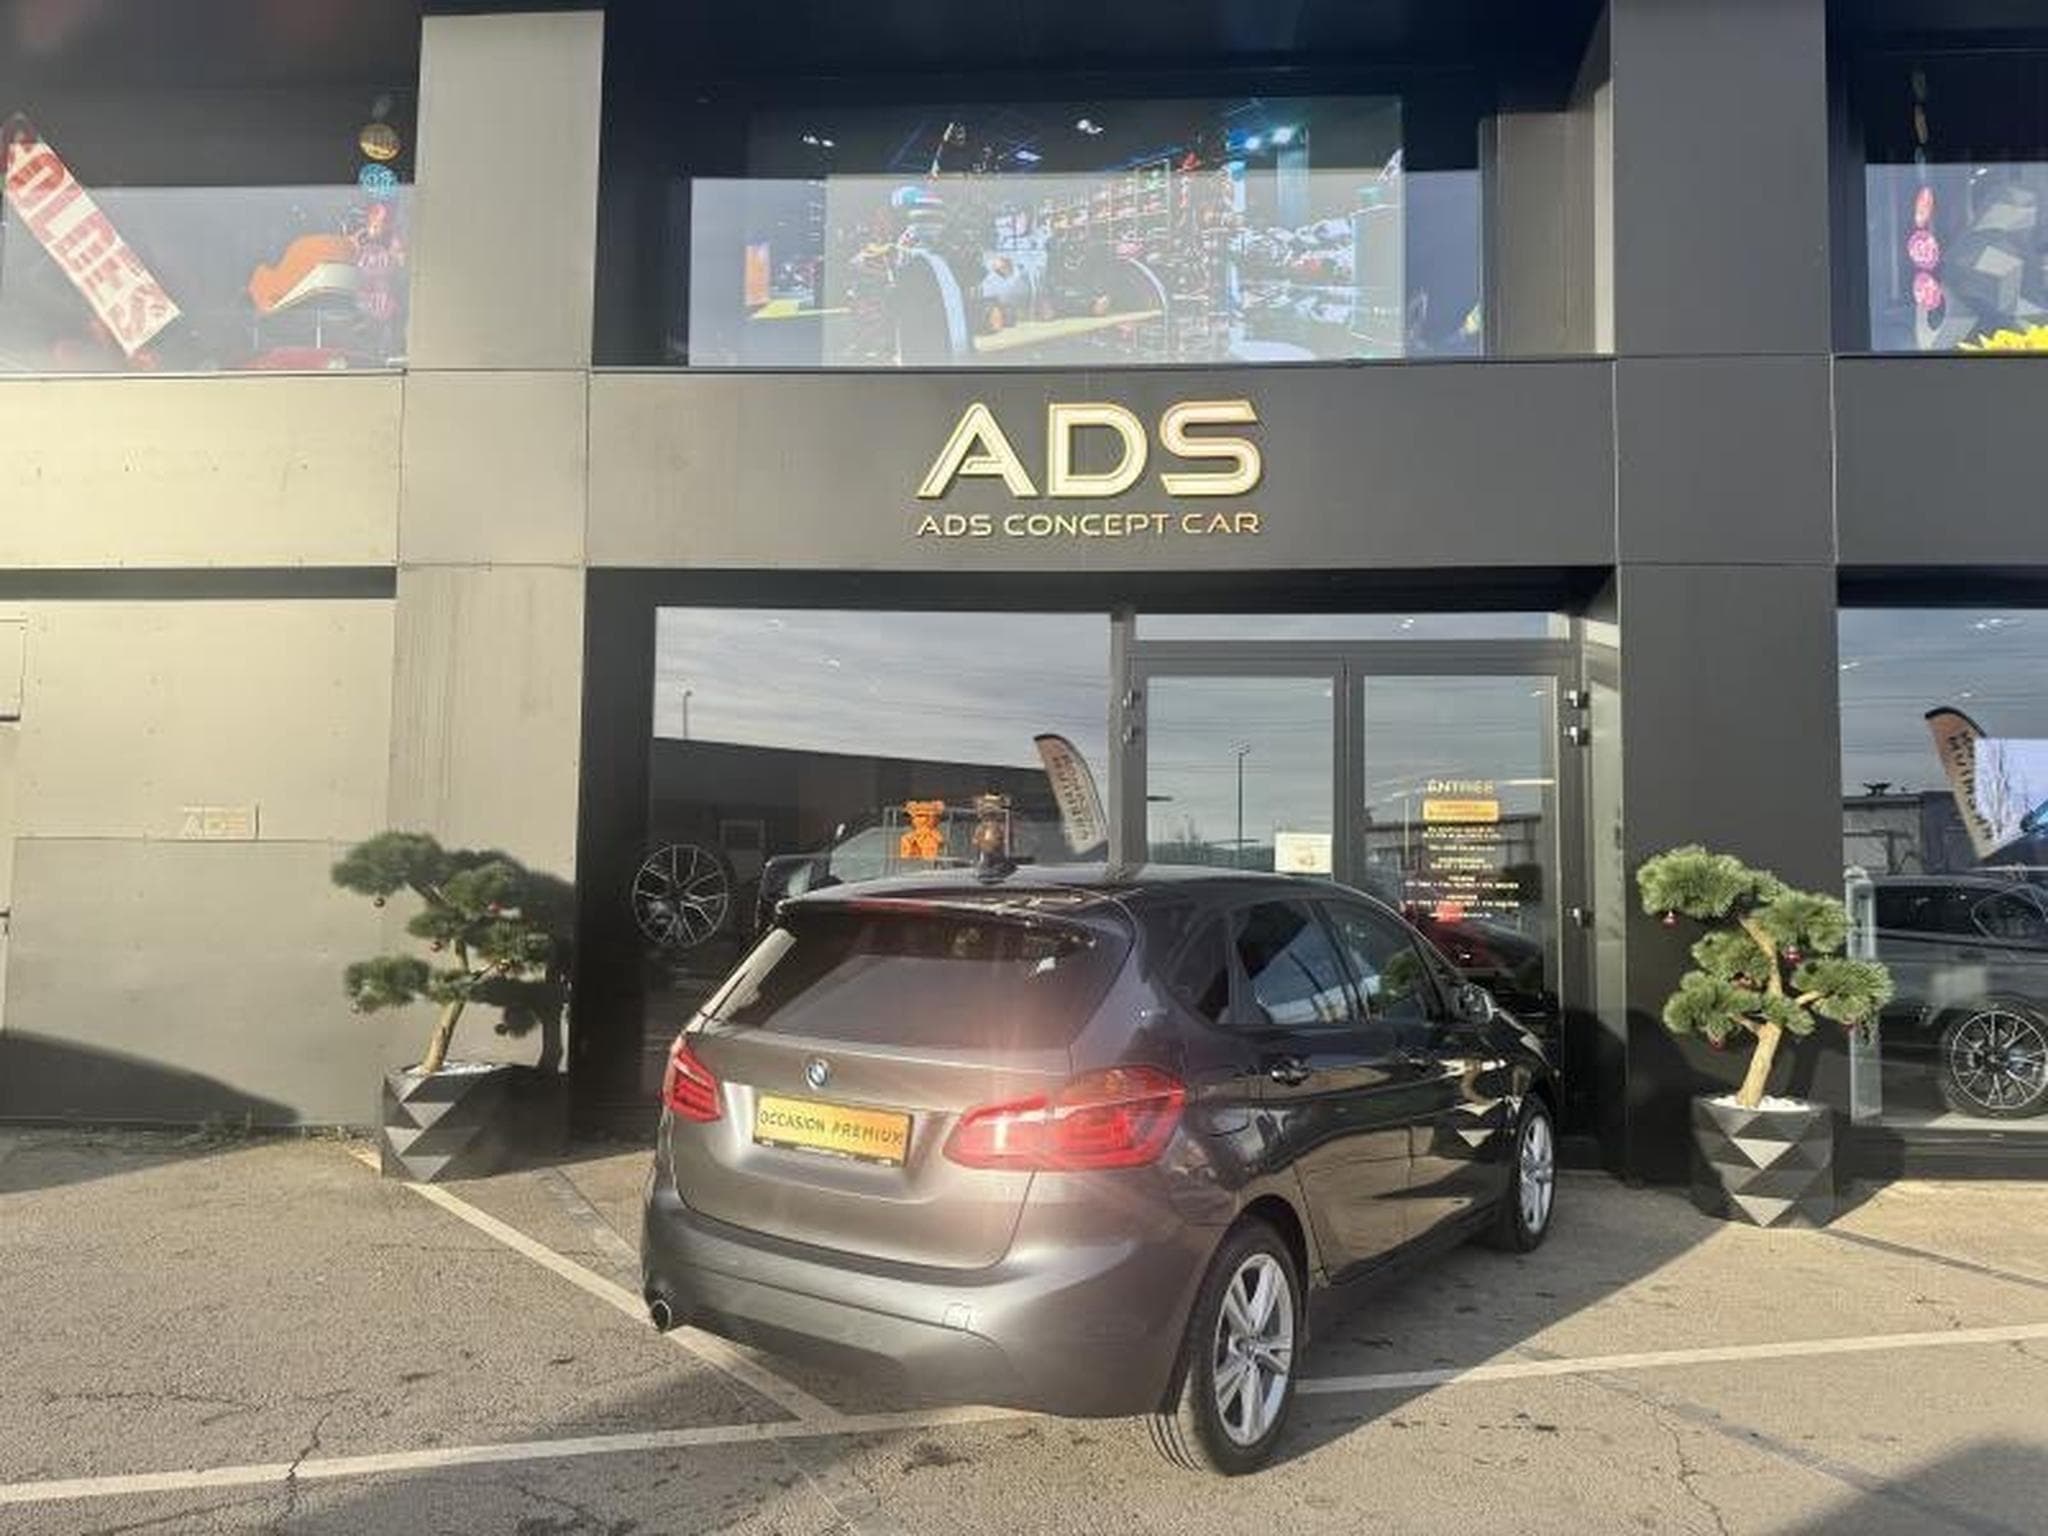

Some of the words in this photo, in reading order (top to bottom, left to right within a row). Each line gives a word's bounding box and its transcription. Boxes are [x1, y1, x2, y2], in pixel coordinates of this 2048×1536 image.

[915, 400, 1262, 498] ADS
[916, 514, 992, 537] ADS
[1003, 512, 1173, 537] CONCEPT
[1181, 511, 1261, 535] CAR
[759, 1108, 826, 1134] OCCASION
